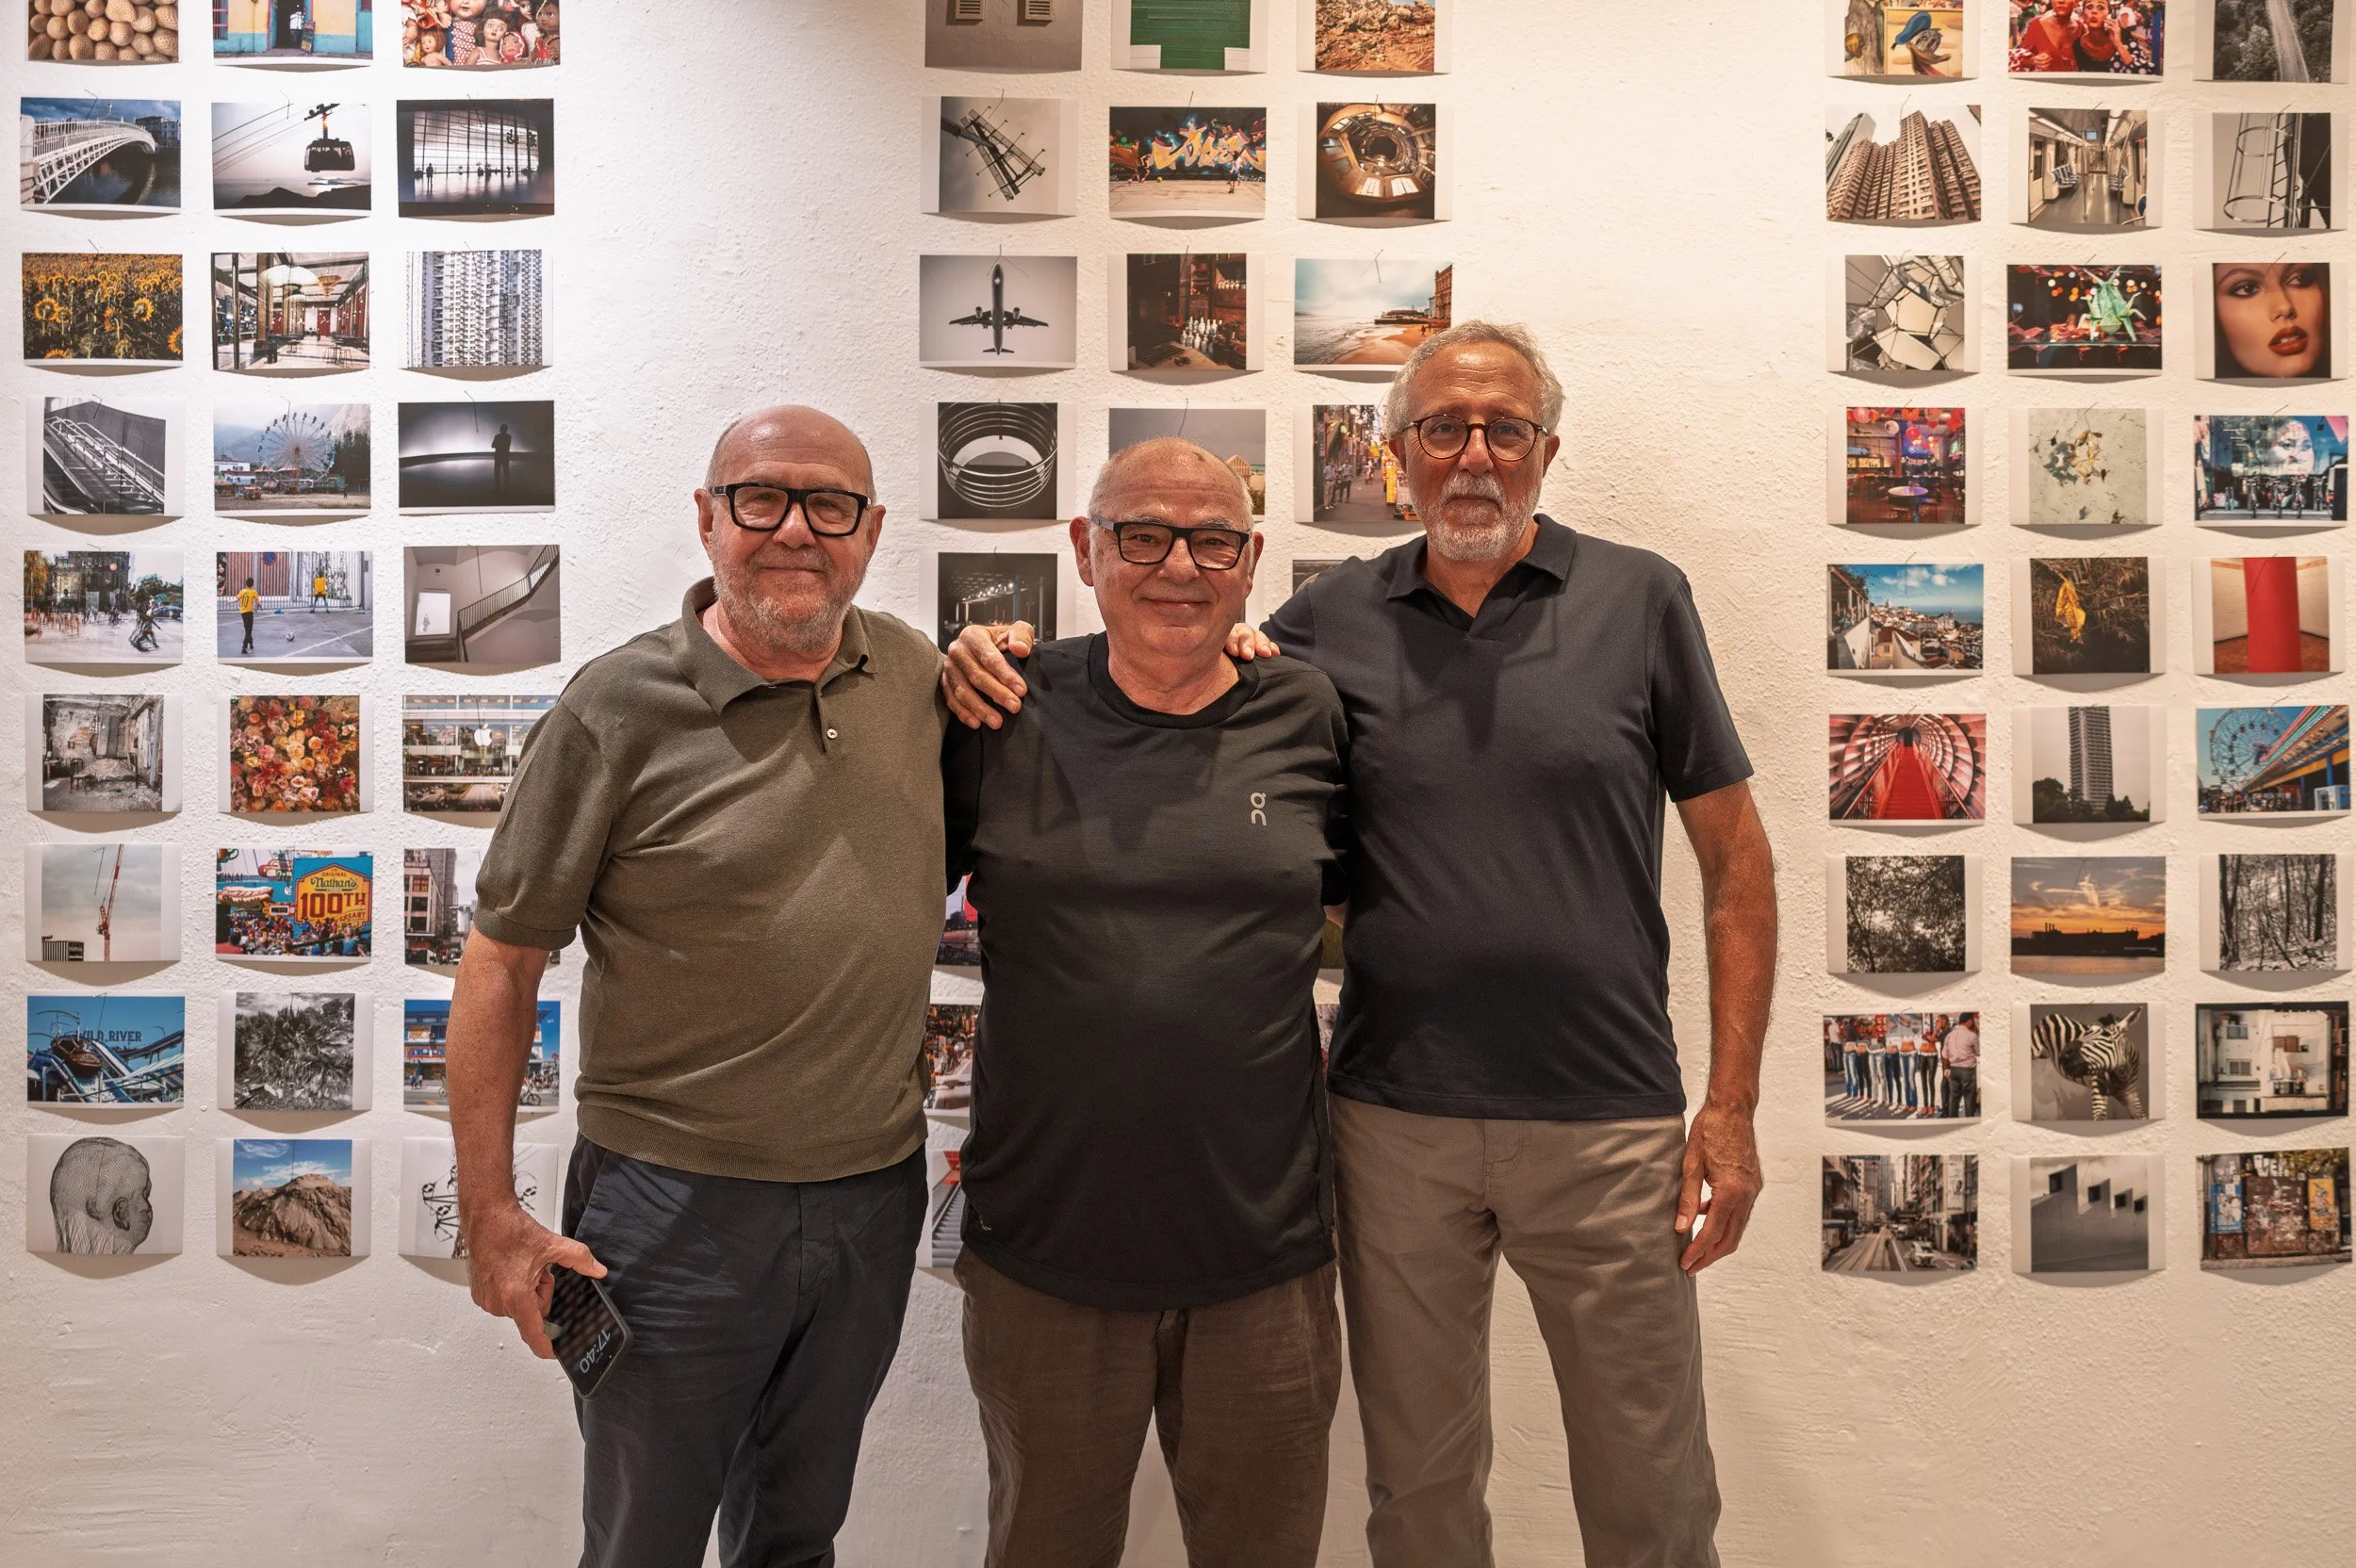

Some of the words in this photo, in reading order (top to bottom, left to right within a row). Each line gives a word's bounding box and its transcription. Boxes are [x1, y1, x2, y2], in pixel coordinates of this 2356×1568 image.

[310, 876, 357, 889] Nathan's
[300, 892, 366, 920] 100TH
[108, 1029, 142, 1042] RIVER
[580, 1329, 611, 1374] 17:40
